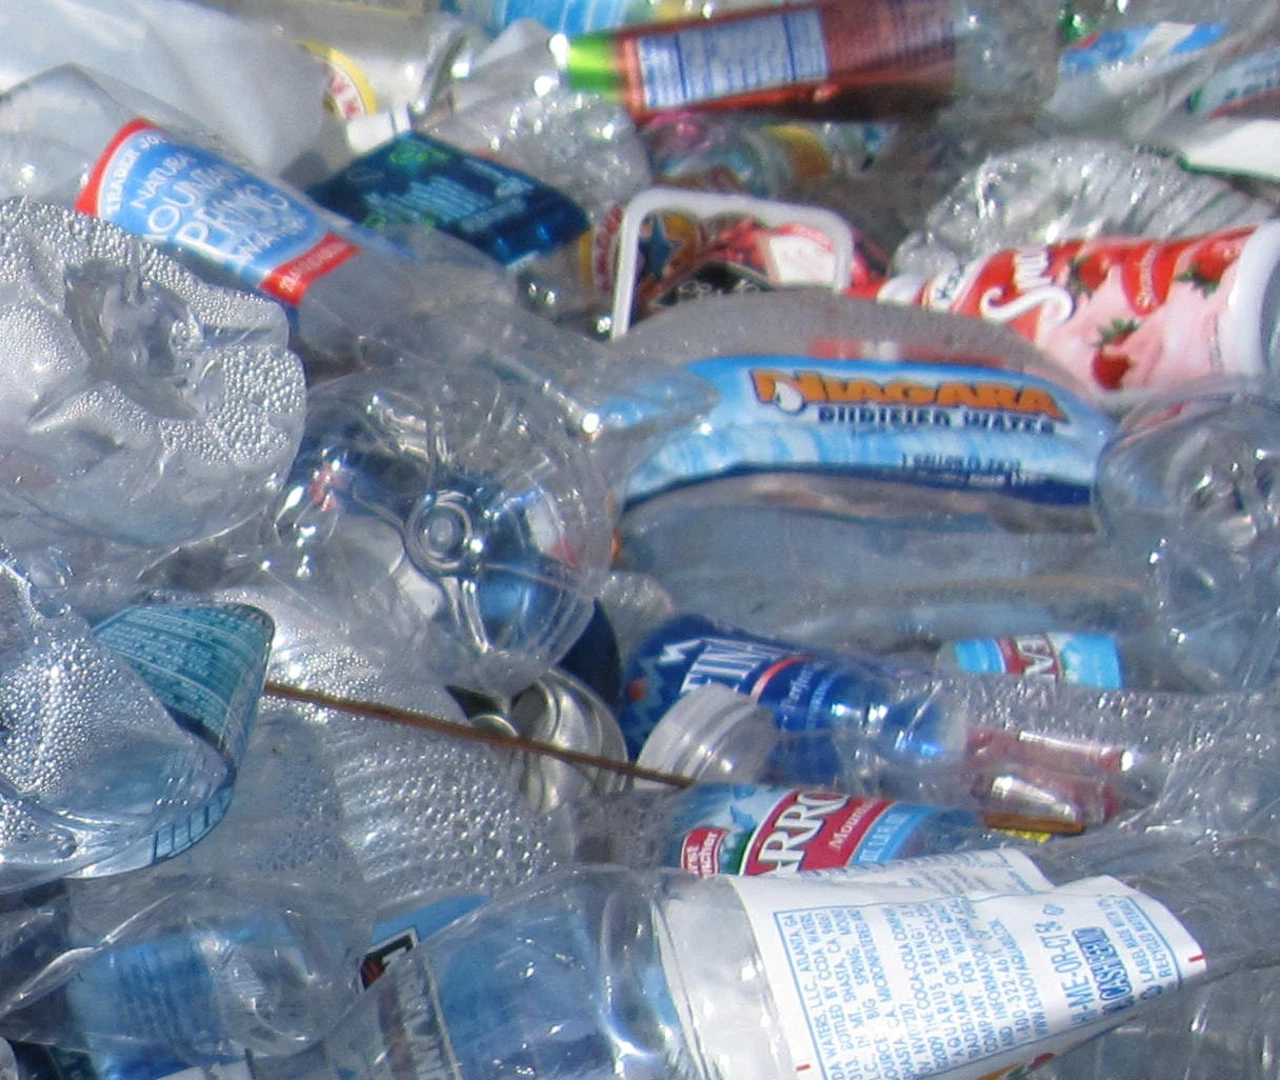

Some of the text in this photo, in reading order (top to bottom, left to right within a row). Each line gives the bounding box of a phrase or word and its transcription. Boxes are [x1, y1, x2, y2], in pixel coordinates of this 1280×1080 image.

[750, 369, 1070, 424] NIAGARA
[824, 936, 840, 955] CA
[1140, 932, 1173, 978] RECYCLED
[812, 946, 838, 1000] BY CCDA
[897, 940, 930, 1012] COCA-COLA
[942, 967, 960, 987] OF
[957, 958, 976, 984] FOR
[1091, 963, 1133, 1000] CASH
[1132, 951, 1155, 983] LABEL
[861, 995, 881, 1020] BIG
